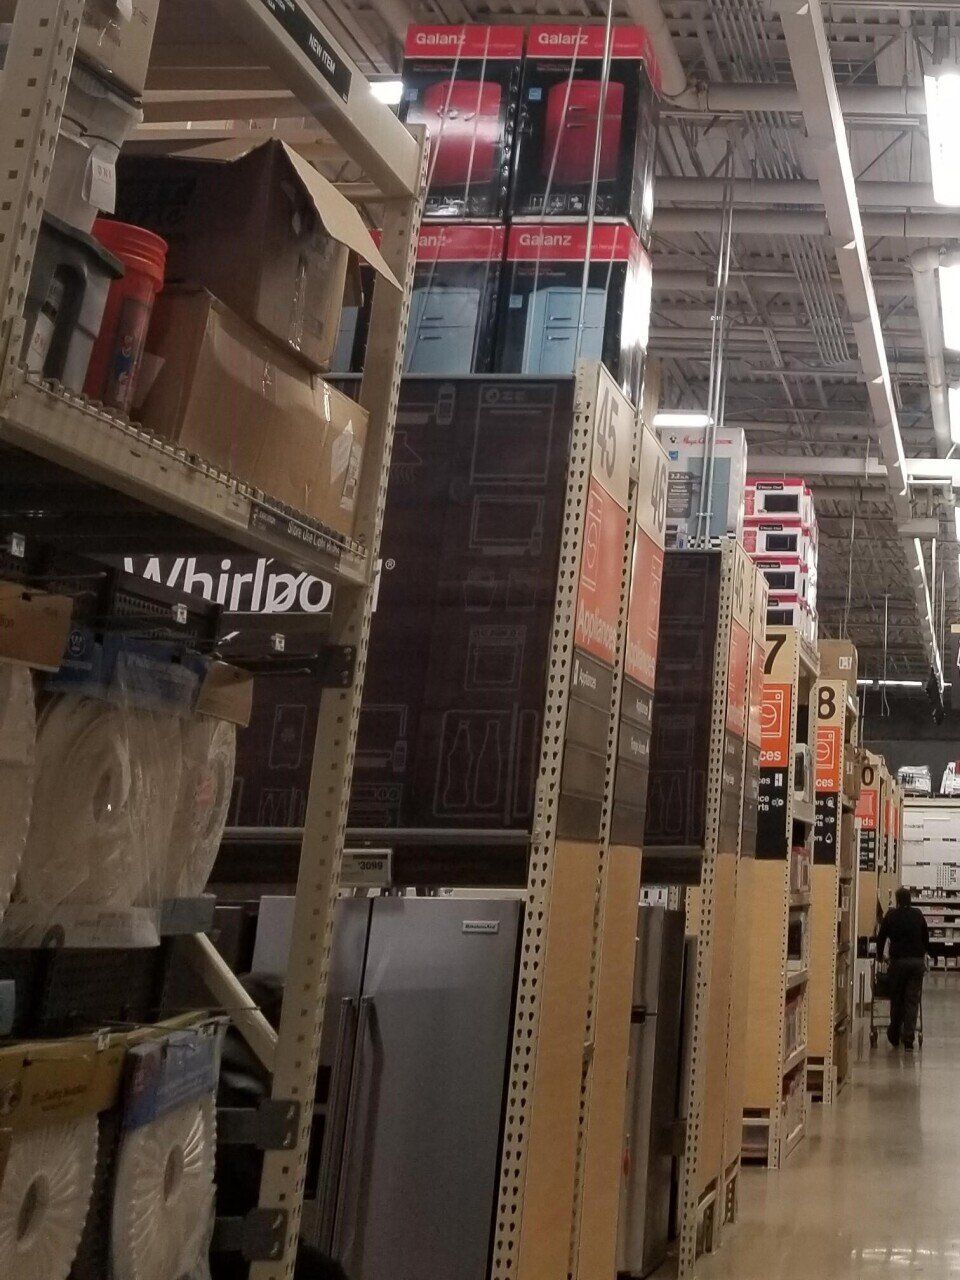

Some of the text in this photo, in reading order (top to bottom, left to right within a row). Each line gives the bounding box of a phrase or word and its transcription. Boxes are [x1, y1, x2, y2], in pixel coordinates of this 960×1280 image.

[309, 33, 336, 75] NEW ITEM
[416, 33, 466, 45] Galanz
[538, 33, 589, 45] Galanz
[419, 235, 447, 246] anz
[519, 234, 571, 246] Galanz
[596, 386, 619, 479] 45
[651, 456, 667, 534] 46
[123, 556, 383, 613] Whirlpol
[763, 633, 787, 675] 7
[817, 685, 836, 720] 8
[861, 766, 874, 786] 0
